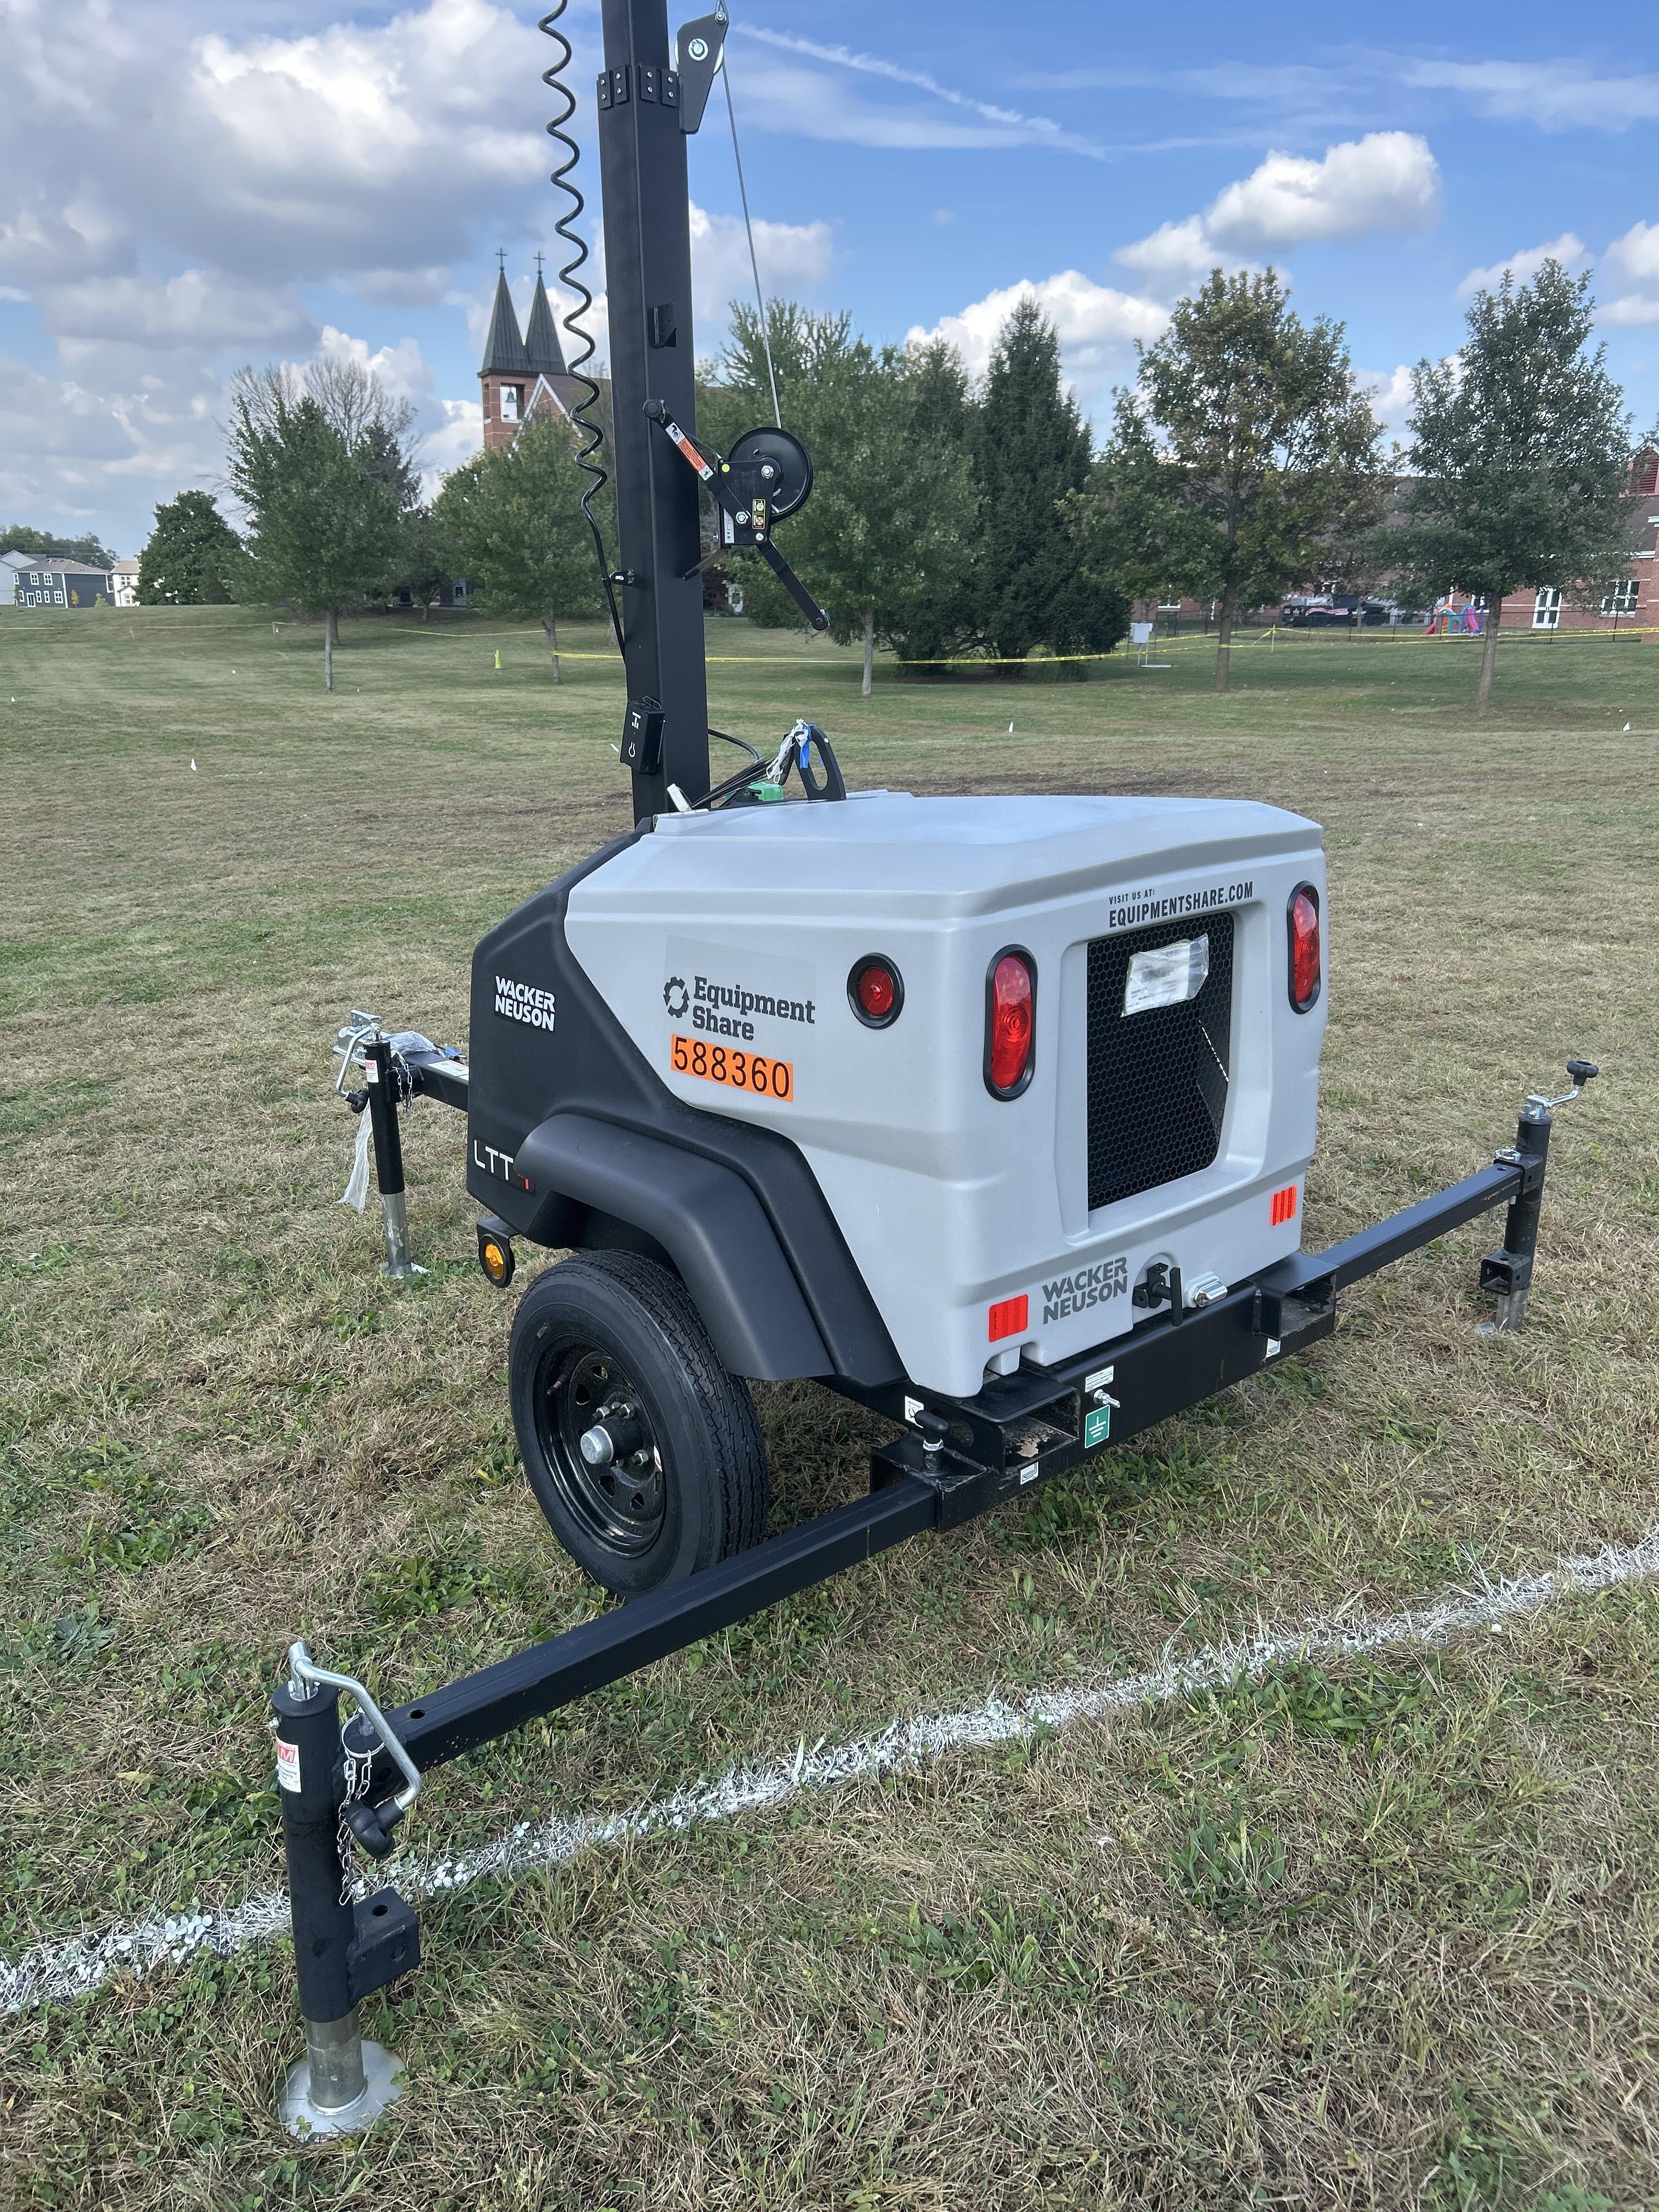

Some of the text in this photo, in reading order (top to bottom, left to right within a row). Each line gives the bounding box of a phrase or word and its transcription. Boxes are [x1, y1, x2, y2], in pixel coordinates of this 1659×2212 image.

[1109, 888, 1155, 905] VISIT US AT:
[1109, 881, 1253, 928] EQUIPMENTSHARE.COM
[495, 975, 556, 1013] WACKER
[495, 994, 555, 1032] NEUSON
[693, 975, 816, 1025] Equipment
[692, 1005, 754, 1041] Share
[674, 1036, 790, 1098] 588360
[1041, 1256, 1128, 1302] WACKER
[1043, 1275, 1128, 1325] NEUSON
